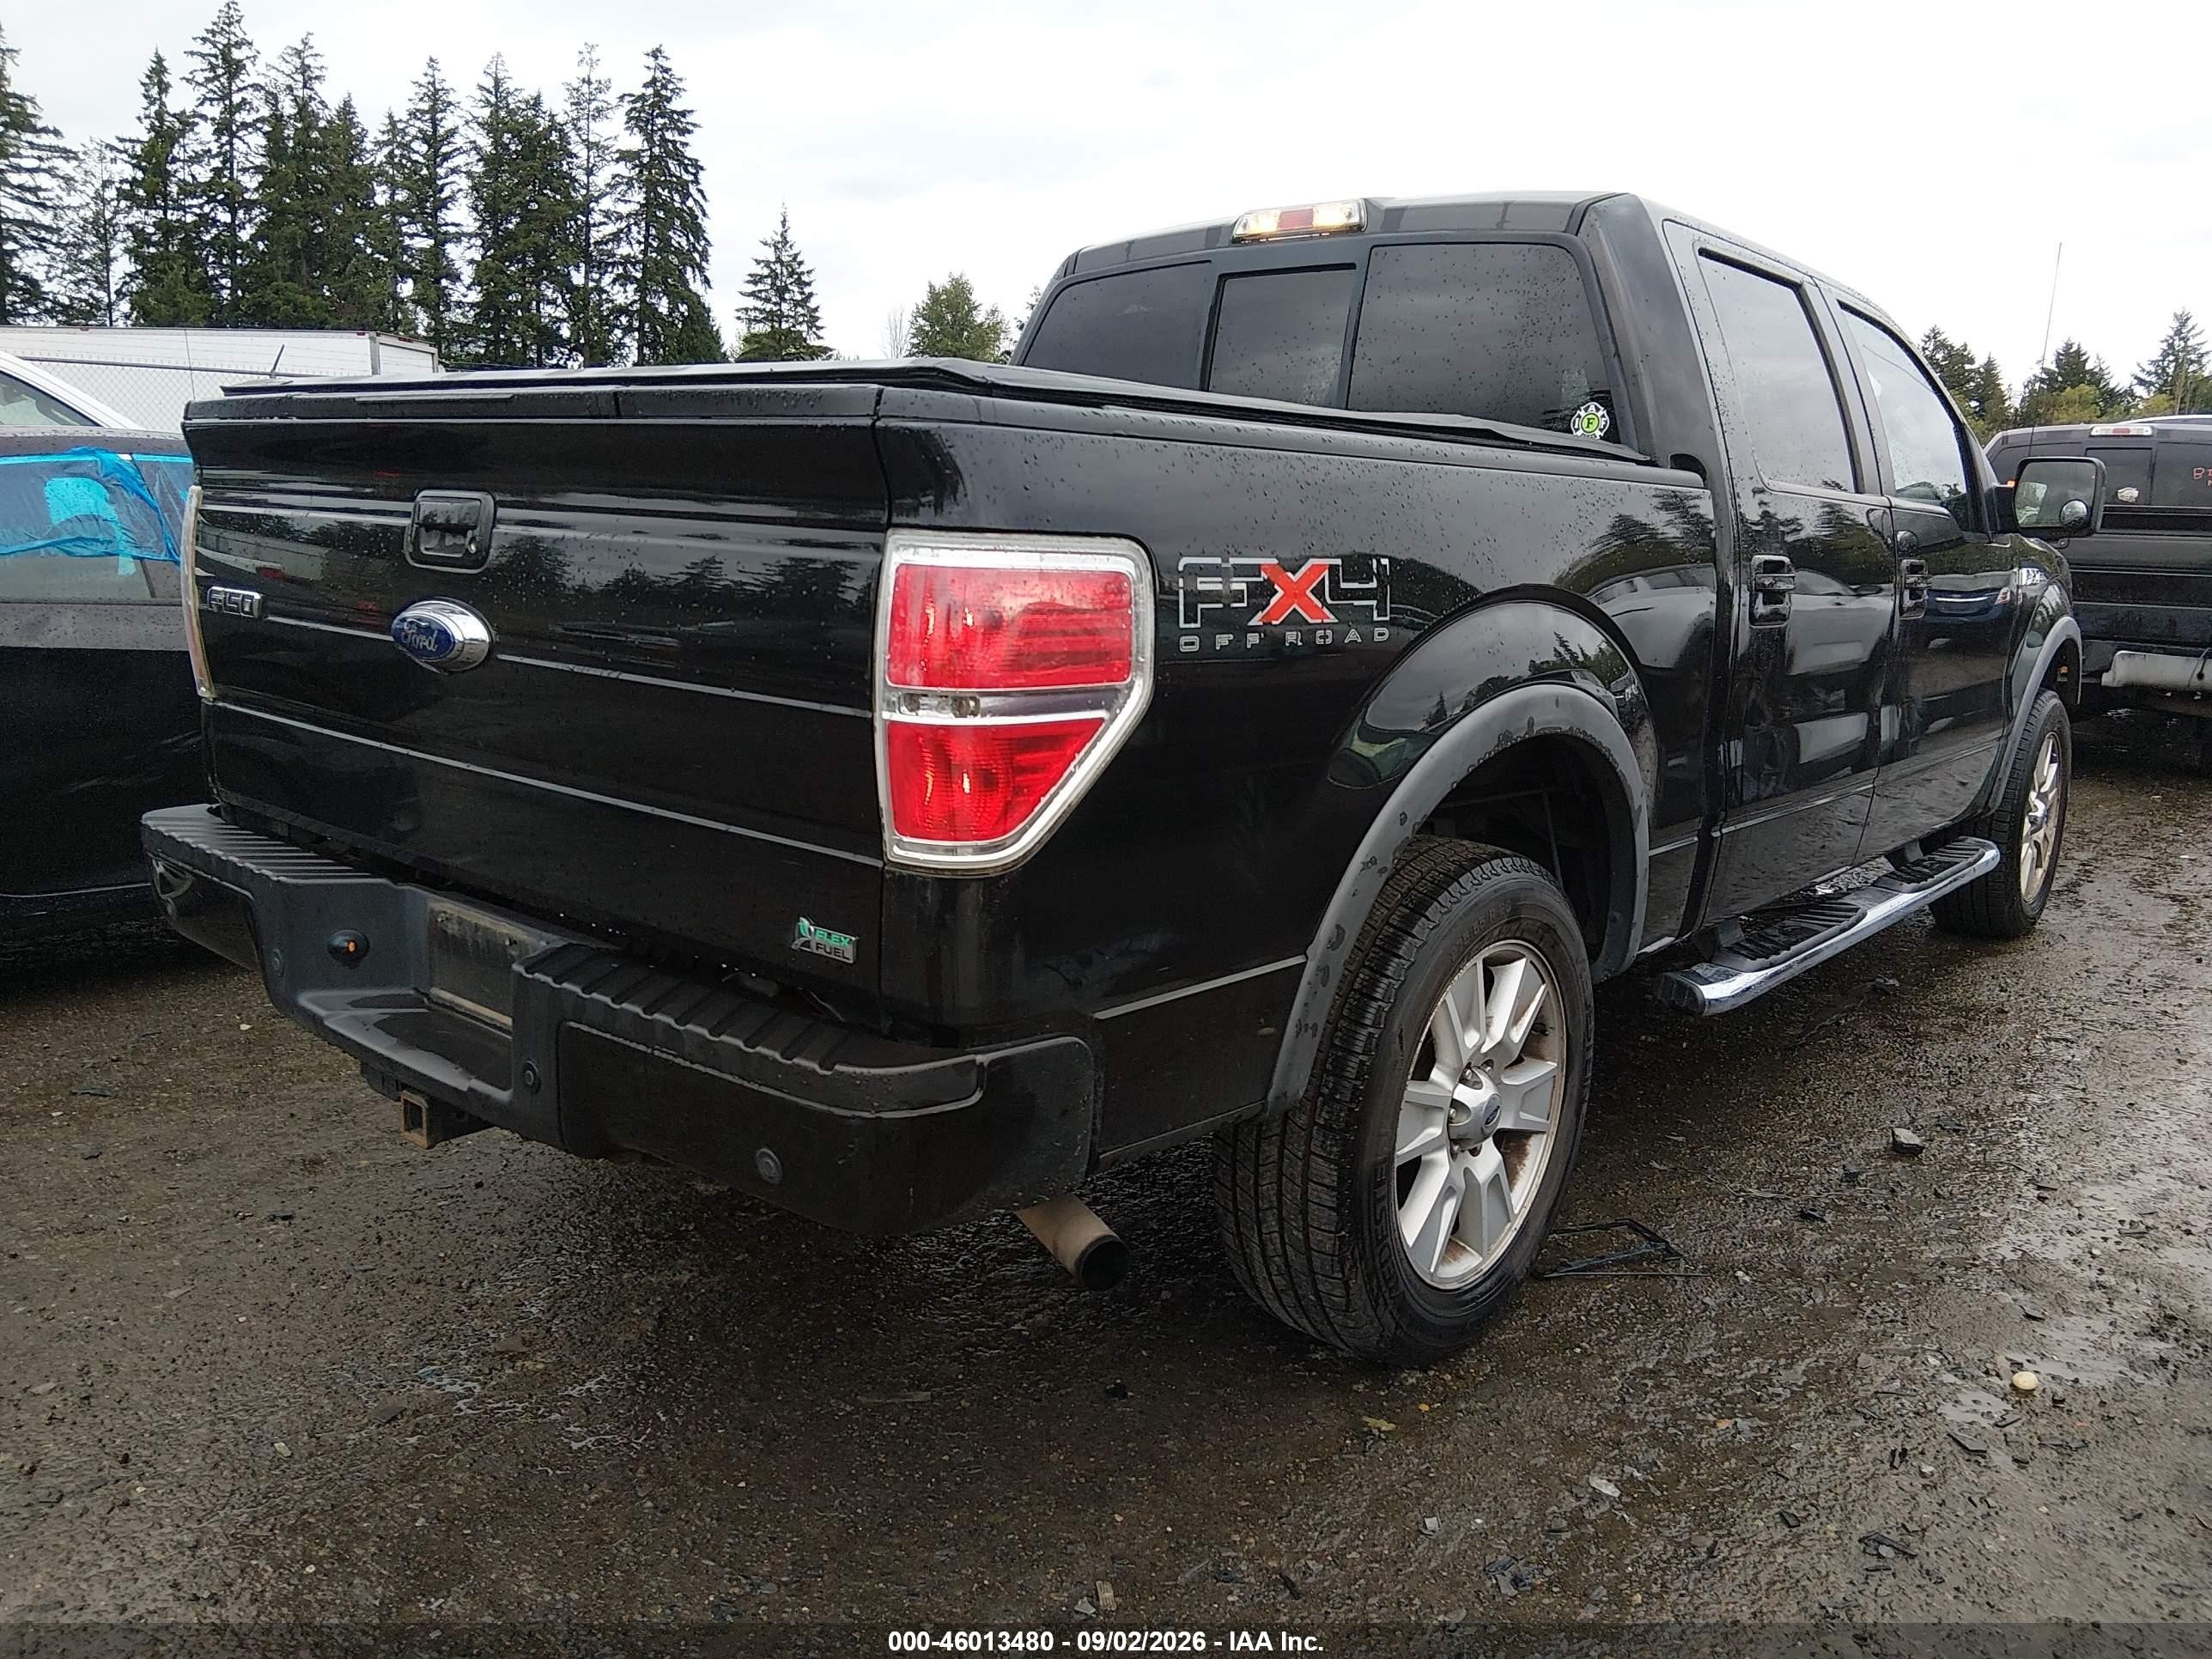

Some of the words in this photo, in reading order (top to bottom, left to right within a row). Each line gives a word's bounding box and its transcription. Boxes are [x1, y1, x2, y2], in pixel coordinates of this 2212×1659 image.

[1177, 556, 1391, 629] FX4
[401, 618, 440, 653] Ford
[1179, 633, 1265, 653] OFF
[1285, 627, 1390, 647] ROAD
[815, 929, 850, 948] FLEX
[816, 942, 850, 960] FUEL
